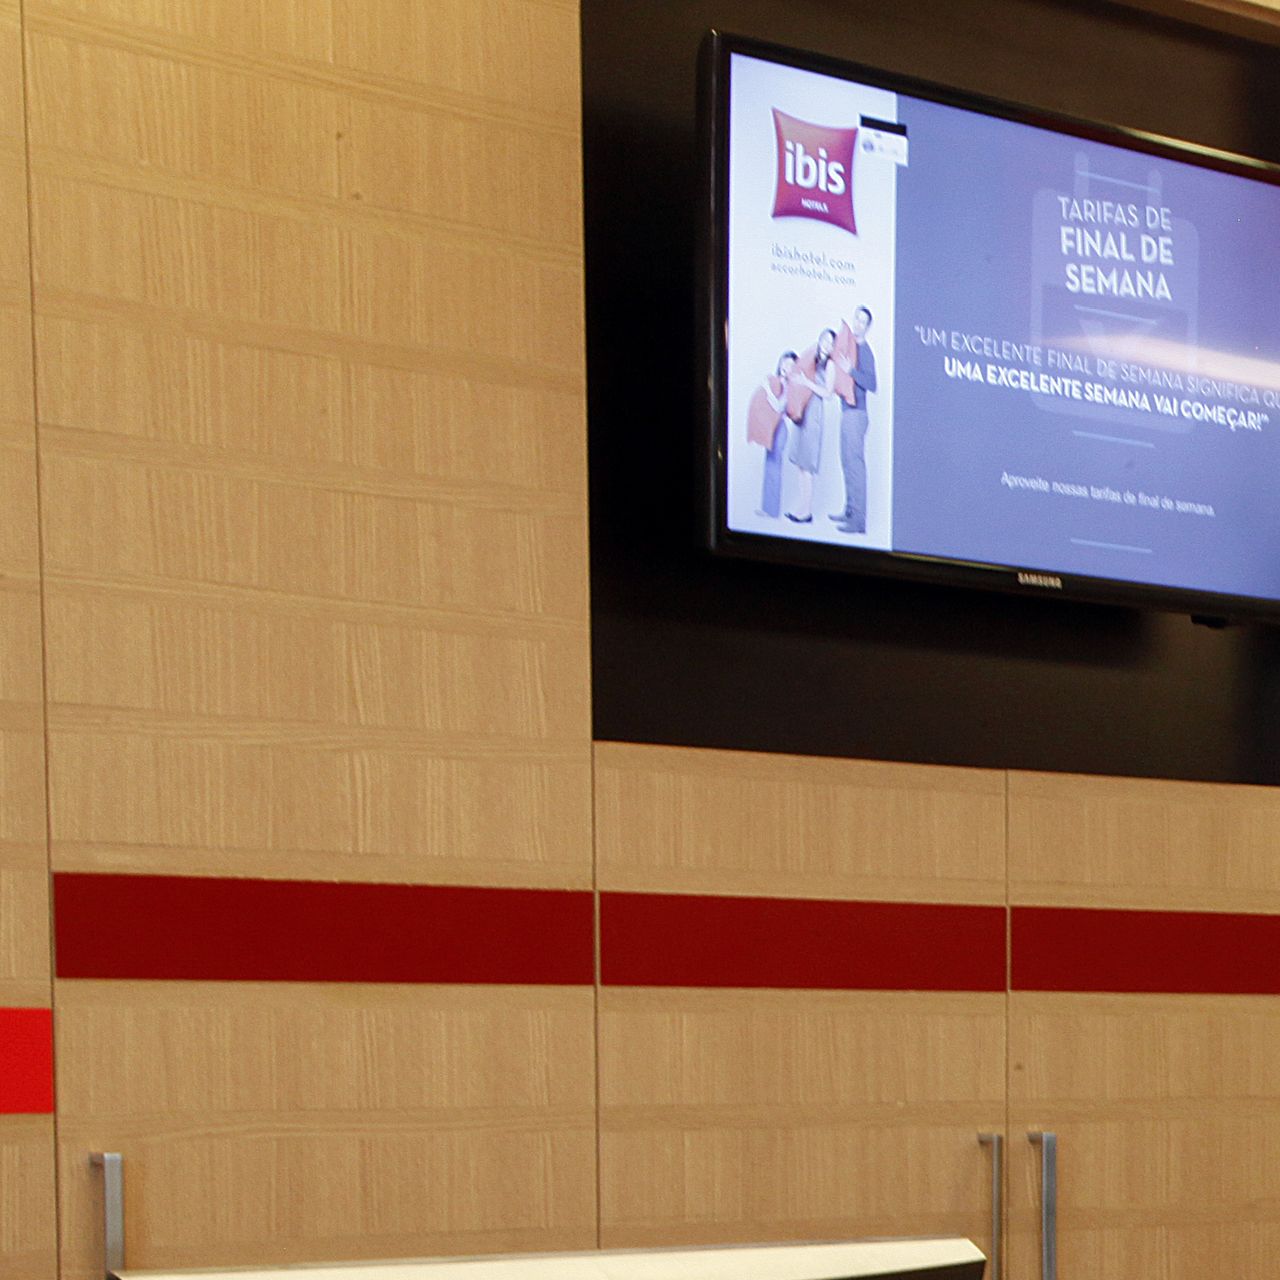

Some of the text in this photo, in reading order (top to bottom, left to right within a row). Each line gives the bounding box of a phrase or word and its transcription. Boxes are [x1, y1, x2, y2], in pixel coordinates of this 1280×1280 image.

[784, 140, 846, 195] ibis
[1057, 195, 1173, 232] TARIFAS DE
[771, 243, 856, 272] ibishotel.com
[1060, 225, 1175, 266] FINAL DE
[770, 261, 856, 286] accorhotels.com
[1065, 261, 1173, 301] SEMANA
[943, 355, 985, 384] UMA
[986, 363, 1083, 401] EXCELENTE
[1084, 381, 1152, 413] SEMANA
[1153, 393, 1179, 417] VAI
[950, 331, 1042, 368] EXCELENTE
[1047, 349, 1093, 377] FINAL
[1096, 357, 1119, 381] DE
[1120, 361, 1184, 393] SEMANA
[1186, 374, 1261, 407] SIGNIFICA
[1000, 470, 1050, 493] Aproveite
[1051, 481, 1089, 499] nossas
[1090, 484, 1122, 505] tarifas
[1123, 489, 1137, 507] de
[1138, 491, 1160, 510] final
[1161, 496, 1174, 511] de
[1017, 571, 1063, 591] SAMSUNG
